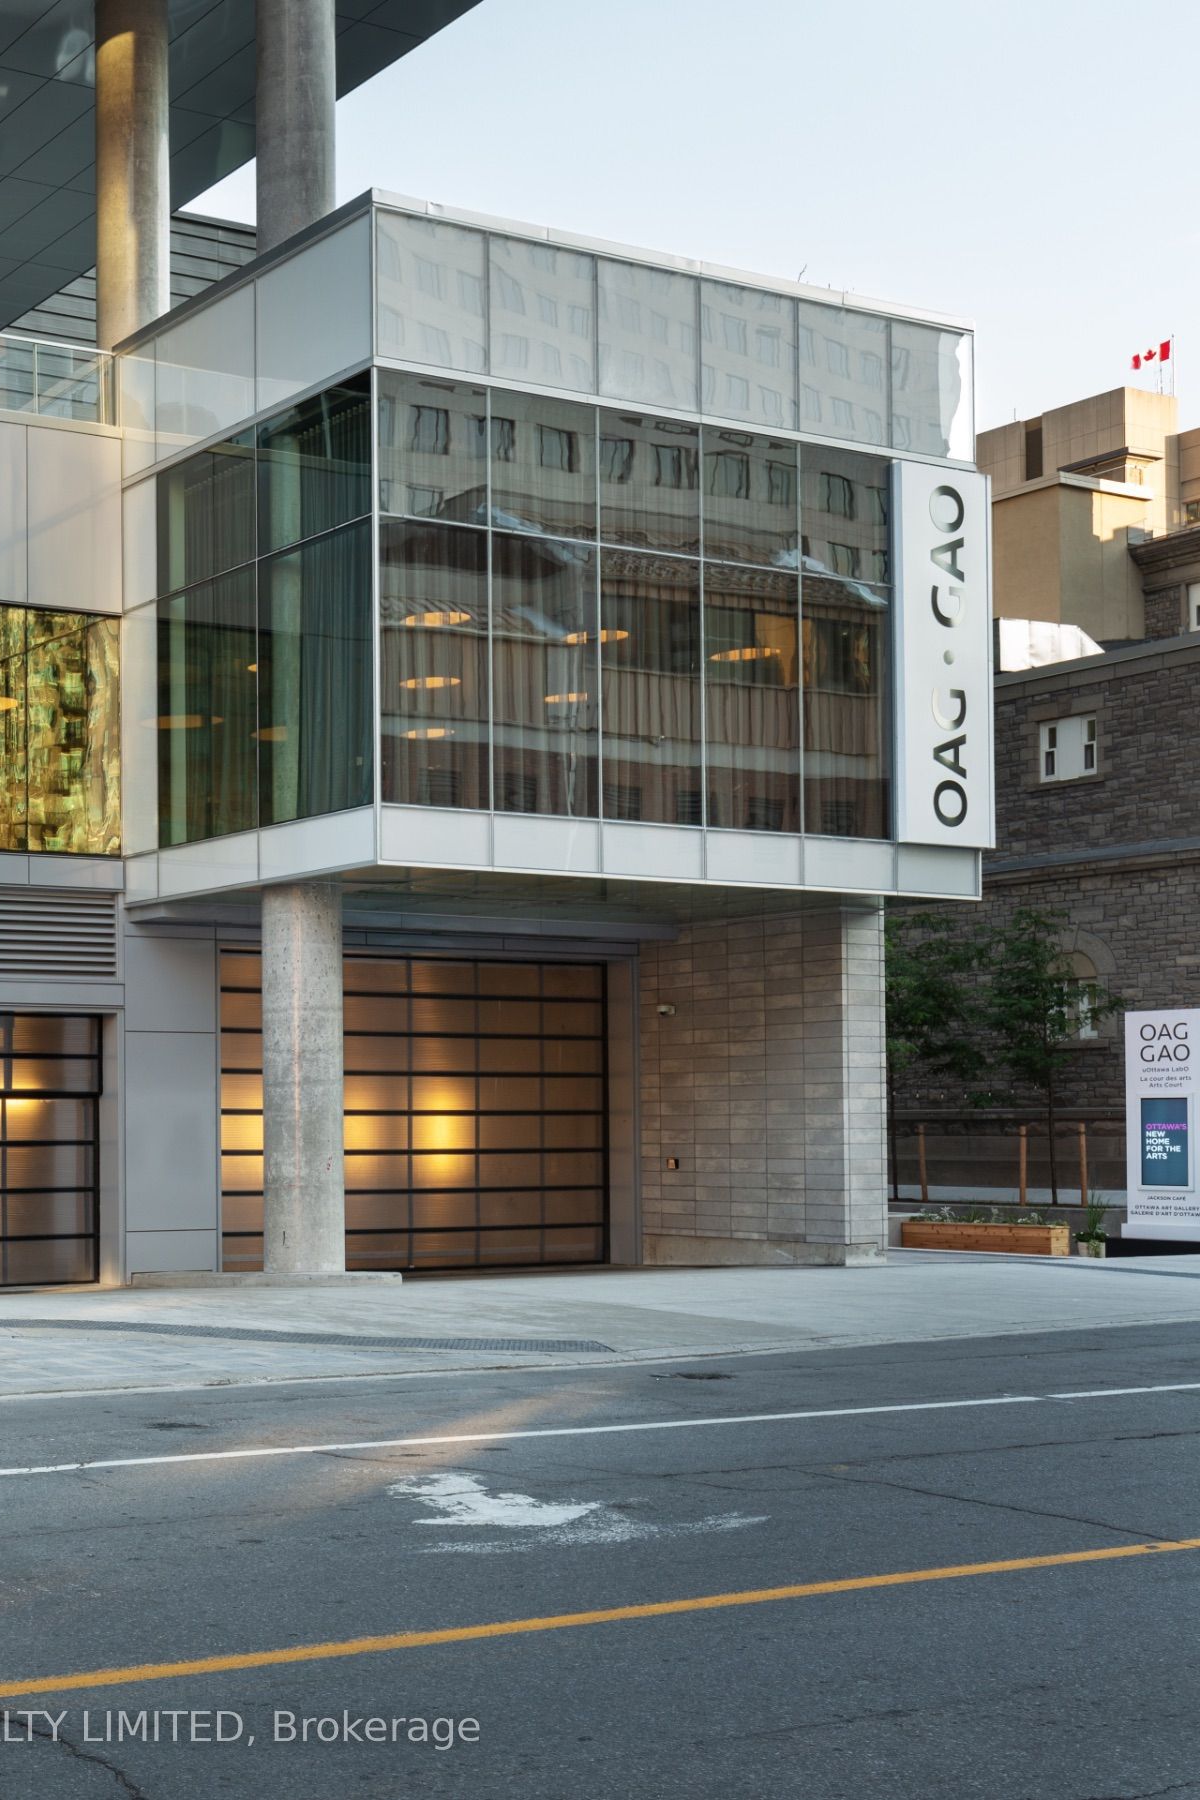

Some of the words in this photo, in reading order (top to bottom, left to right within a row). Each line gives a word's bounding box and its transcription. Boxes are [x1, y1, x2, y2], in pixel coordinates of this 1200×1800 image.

[928, 484, 966, 629] GAO
[931, 687, 968, 828] OAG
[1140, 1022, 1188, 1041] OAG
[1140, 1043, 1190, 1062] GAO
[1145, 1152, 1167, 1160] ARTS
